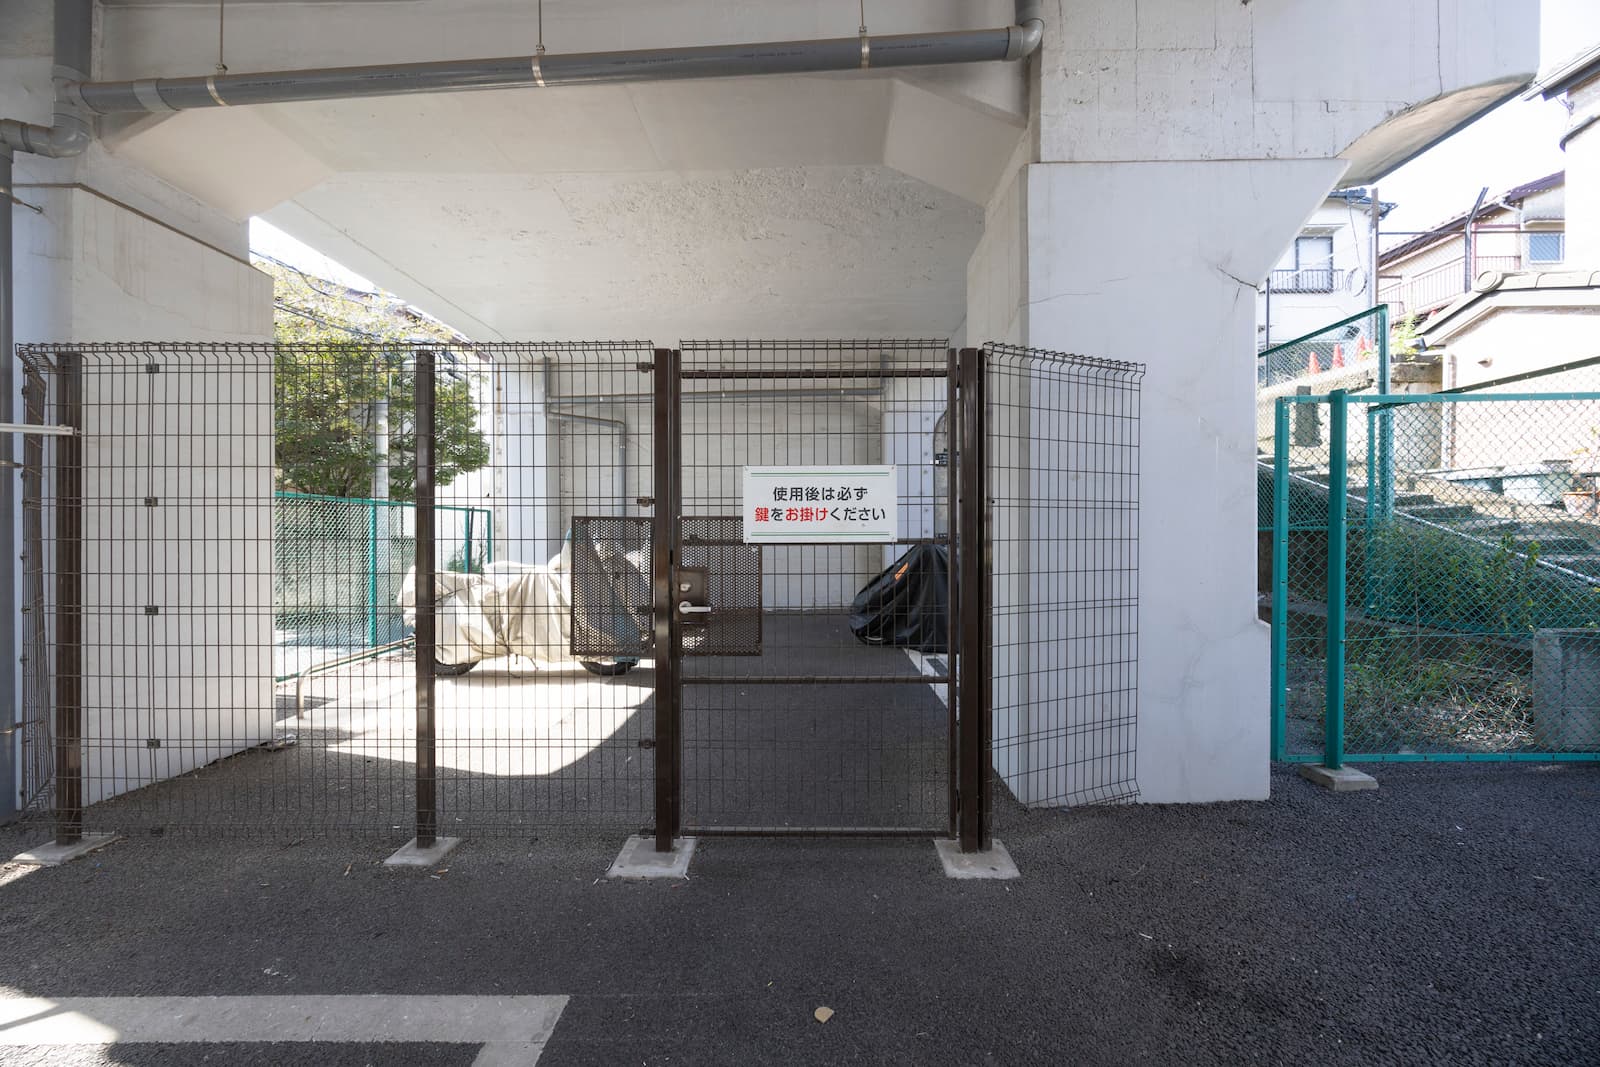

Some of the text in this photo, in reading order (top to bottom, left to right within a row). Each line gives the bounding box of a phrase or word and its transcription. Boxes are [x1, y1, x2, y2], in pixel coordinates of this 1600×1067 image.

[772, 486, 868, 502] 使用後は必ず
[755, 506, 886, 522] 鍵をお掛けください
